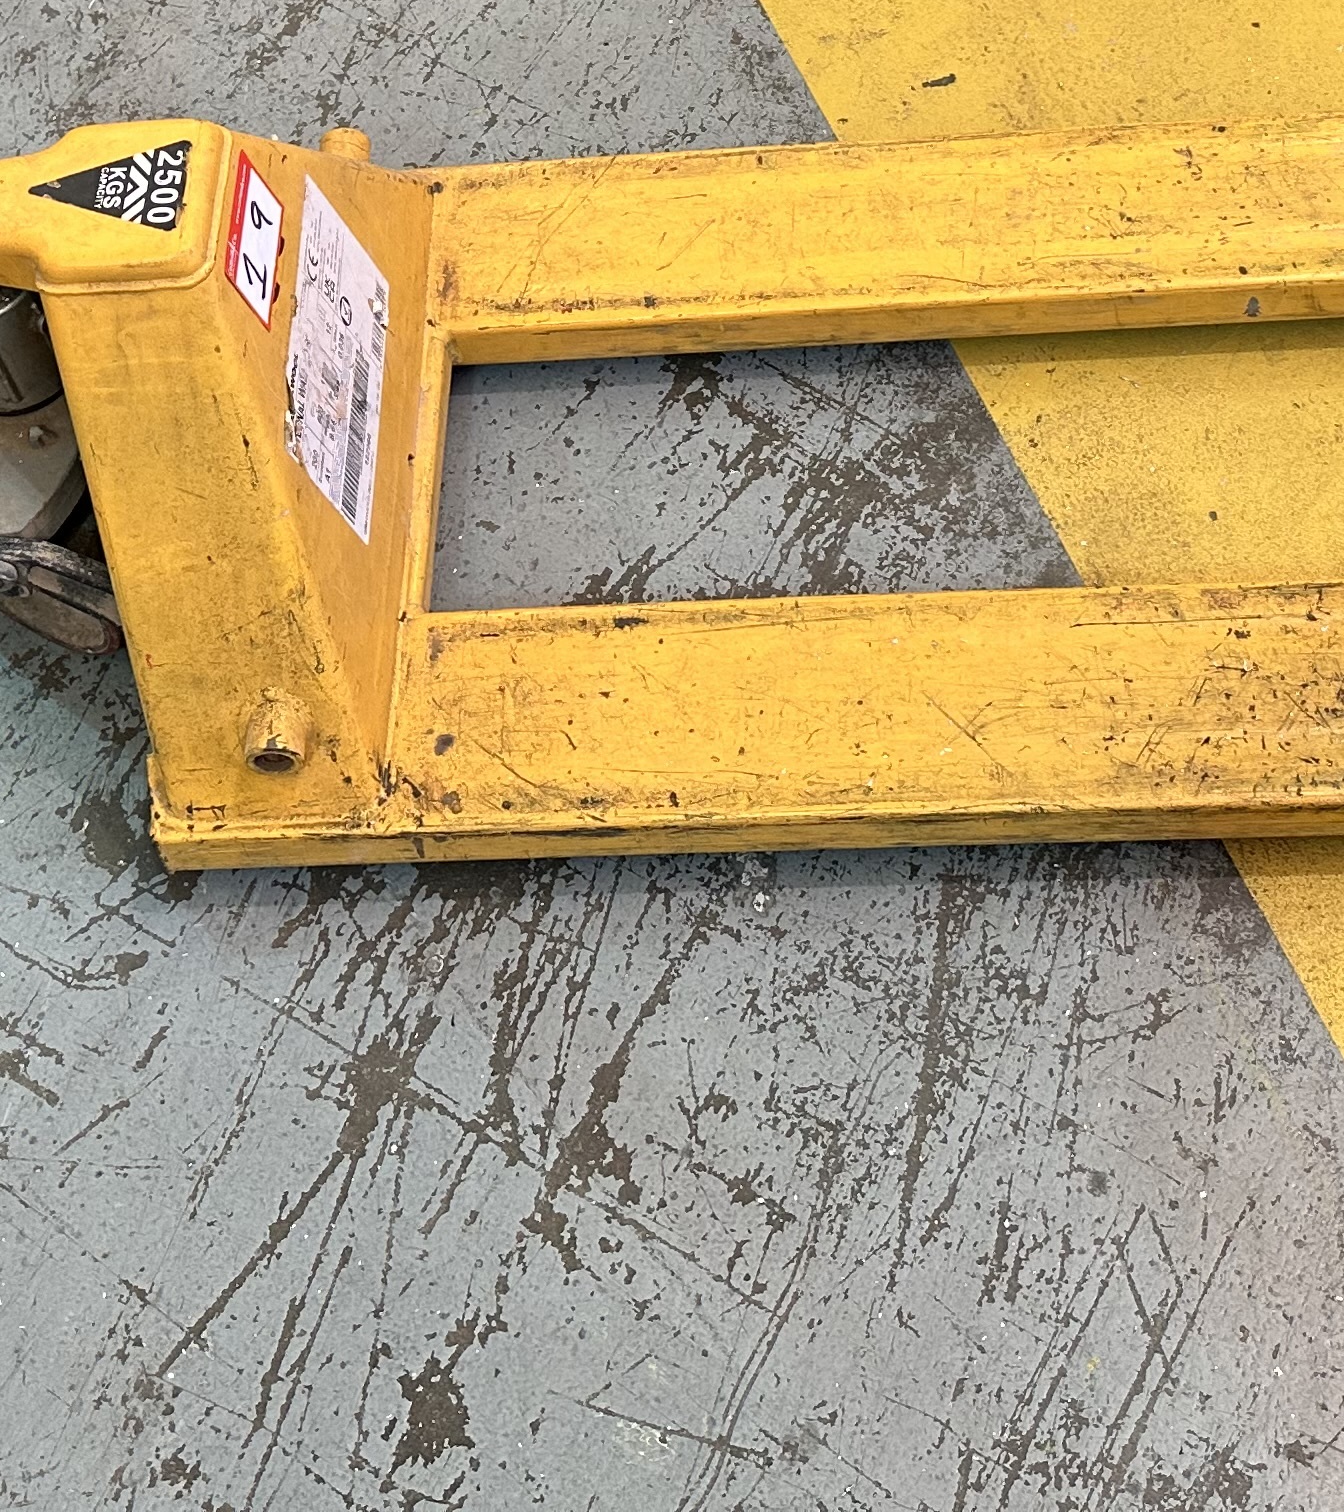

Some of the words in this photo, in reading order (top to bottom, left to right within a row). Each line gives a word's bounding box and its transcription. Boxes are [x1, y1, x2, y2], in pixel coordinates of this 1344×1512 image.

[94, 167, 109, 208] CAPACITY
[103, 167, 127, 208] KGS
[147, 150, 184, 223] 2500
